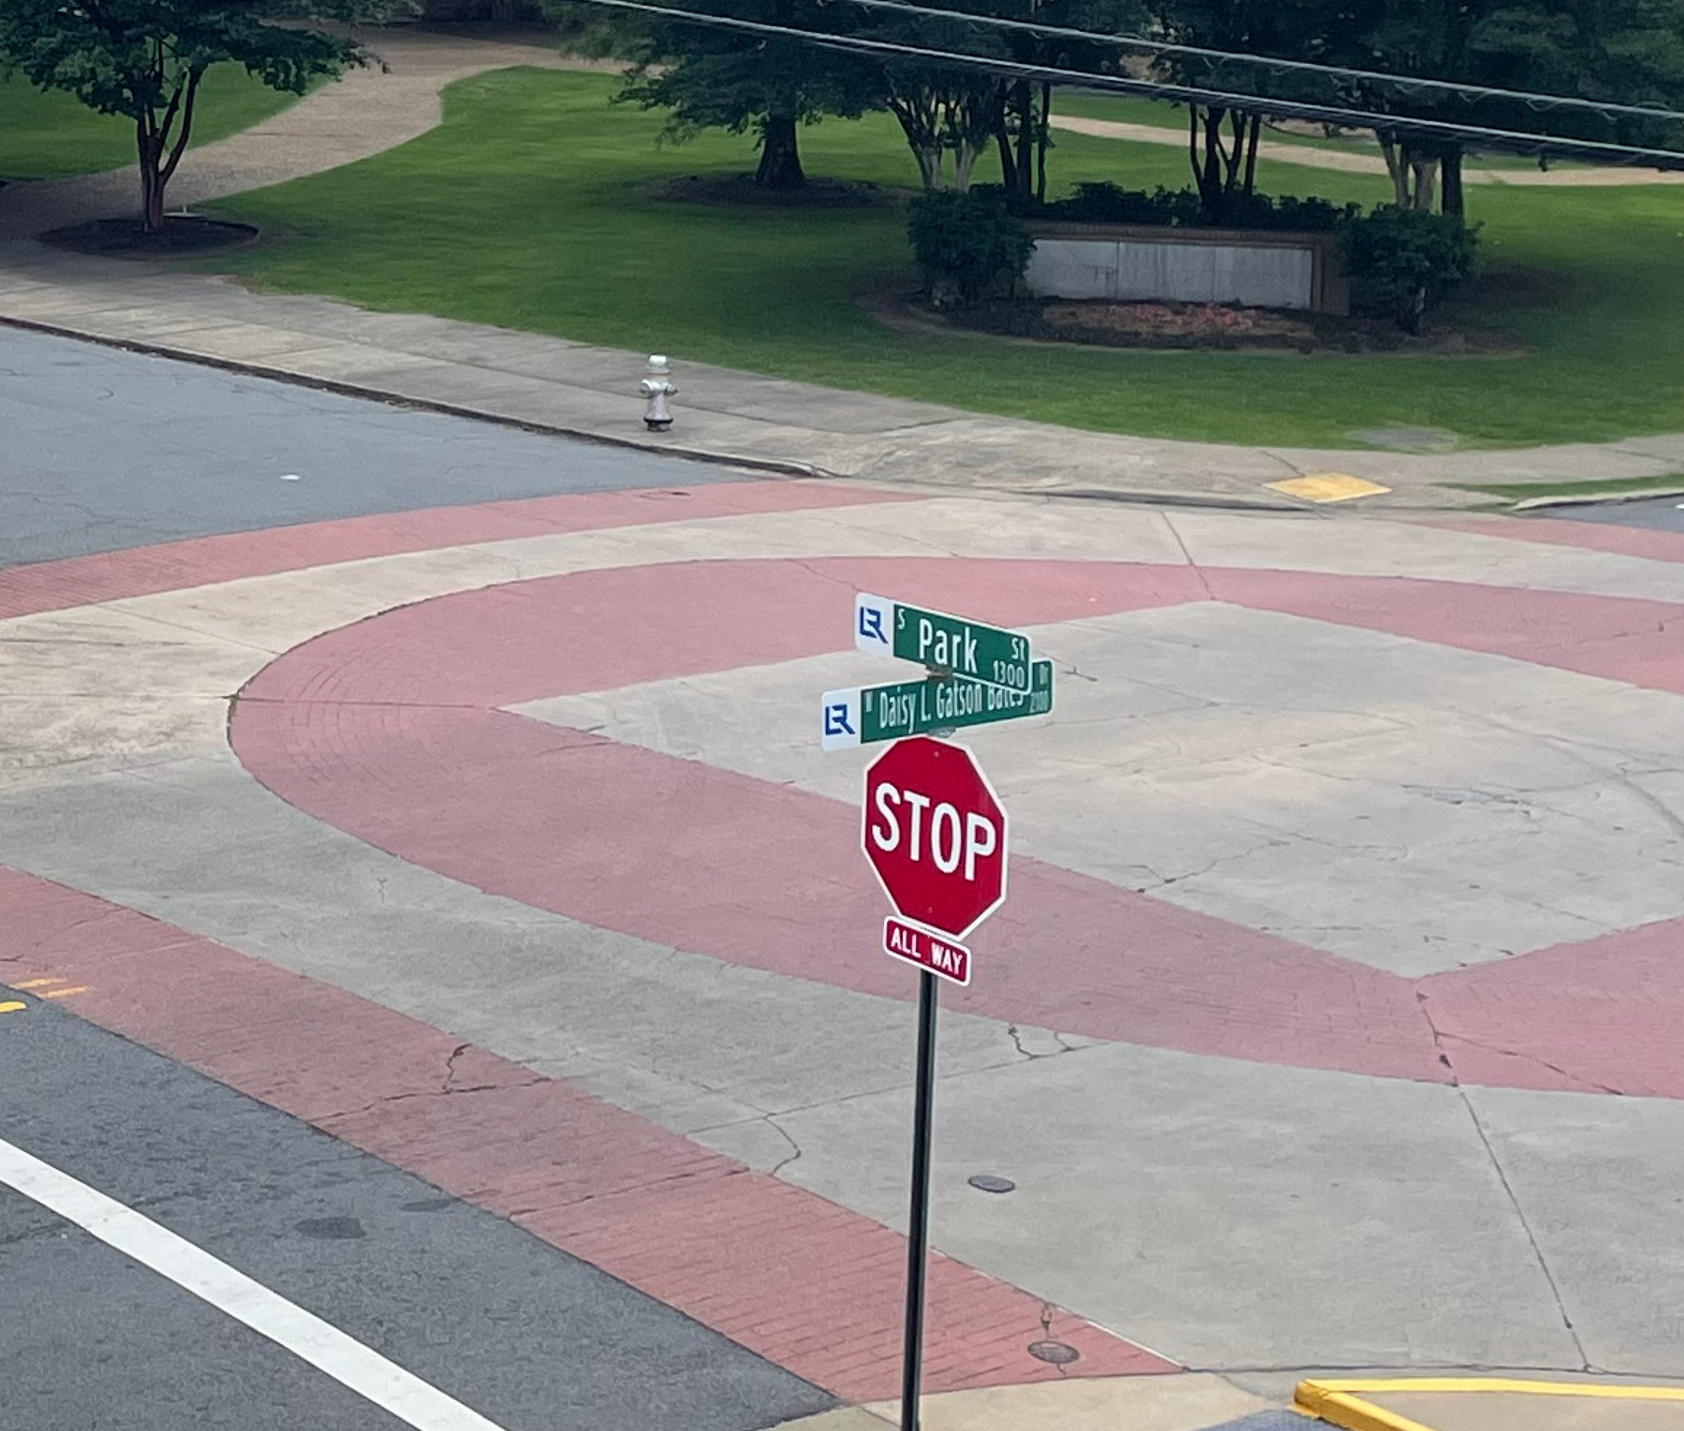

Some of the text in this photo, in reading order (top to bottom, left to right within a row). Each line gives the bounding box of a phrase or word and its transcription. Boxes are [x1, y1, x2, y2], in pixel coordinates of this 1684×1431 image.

[897, 608, 1025, 674] S Park St
[993, 659, 1025, 688] 1300
[879, 685, 917, 734] Daisy
[921, 685, 932, 722] L.
[936, 680, 983, 719] Gatson
[871, 782, 996, 881] STOP
[890, 927, 963, 975] ALL WAY
